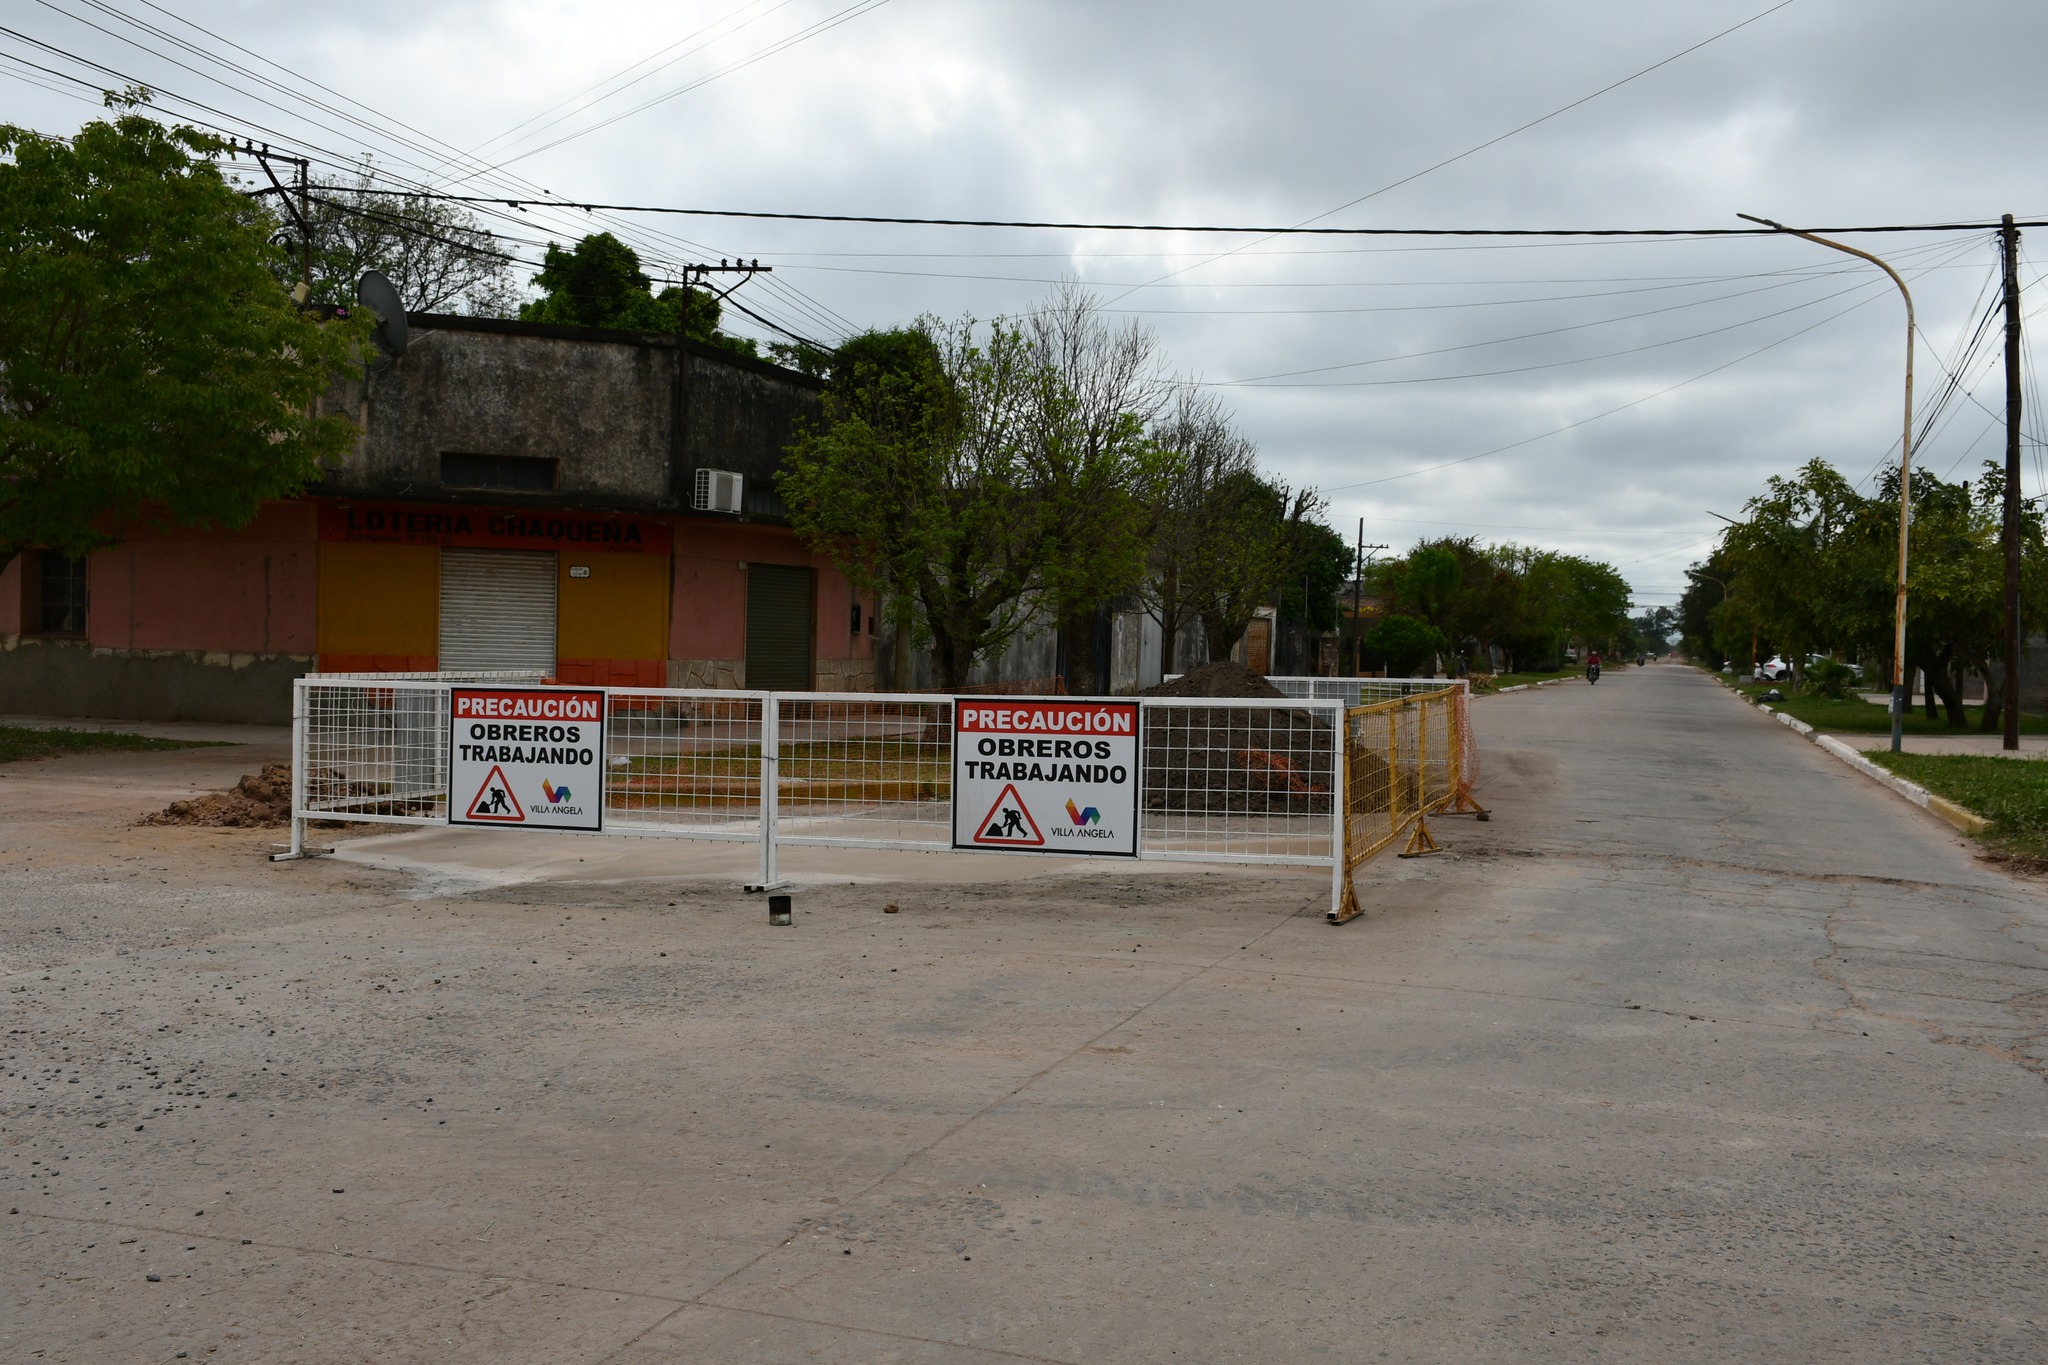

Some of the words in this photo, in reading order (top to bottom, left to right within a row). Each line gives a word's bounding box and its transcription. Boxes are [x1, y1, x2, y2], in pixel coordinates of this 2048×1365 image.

[347, 509, 473, 535] LOTERIA
[458, 696, 597, 719] PRECAUCIÓN
[963, 707, 1131, 732] PRECAUCIÓN
[470, 723, 581, 743] OBREROS
[459, 744, 593, 766] TRABAJANDO
[977, 737, 1111, 760] OBREROS
[965, 760, 1127, 784] TRABAJANDO
[530, 804, 550, 814] VILLA
[551, 805, 583, 815] ANGELA
[1051, 827, 1075, 838] VILLA
[1076, 828, 1115, 839] ANGELA
